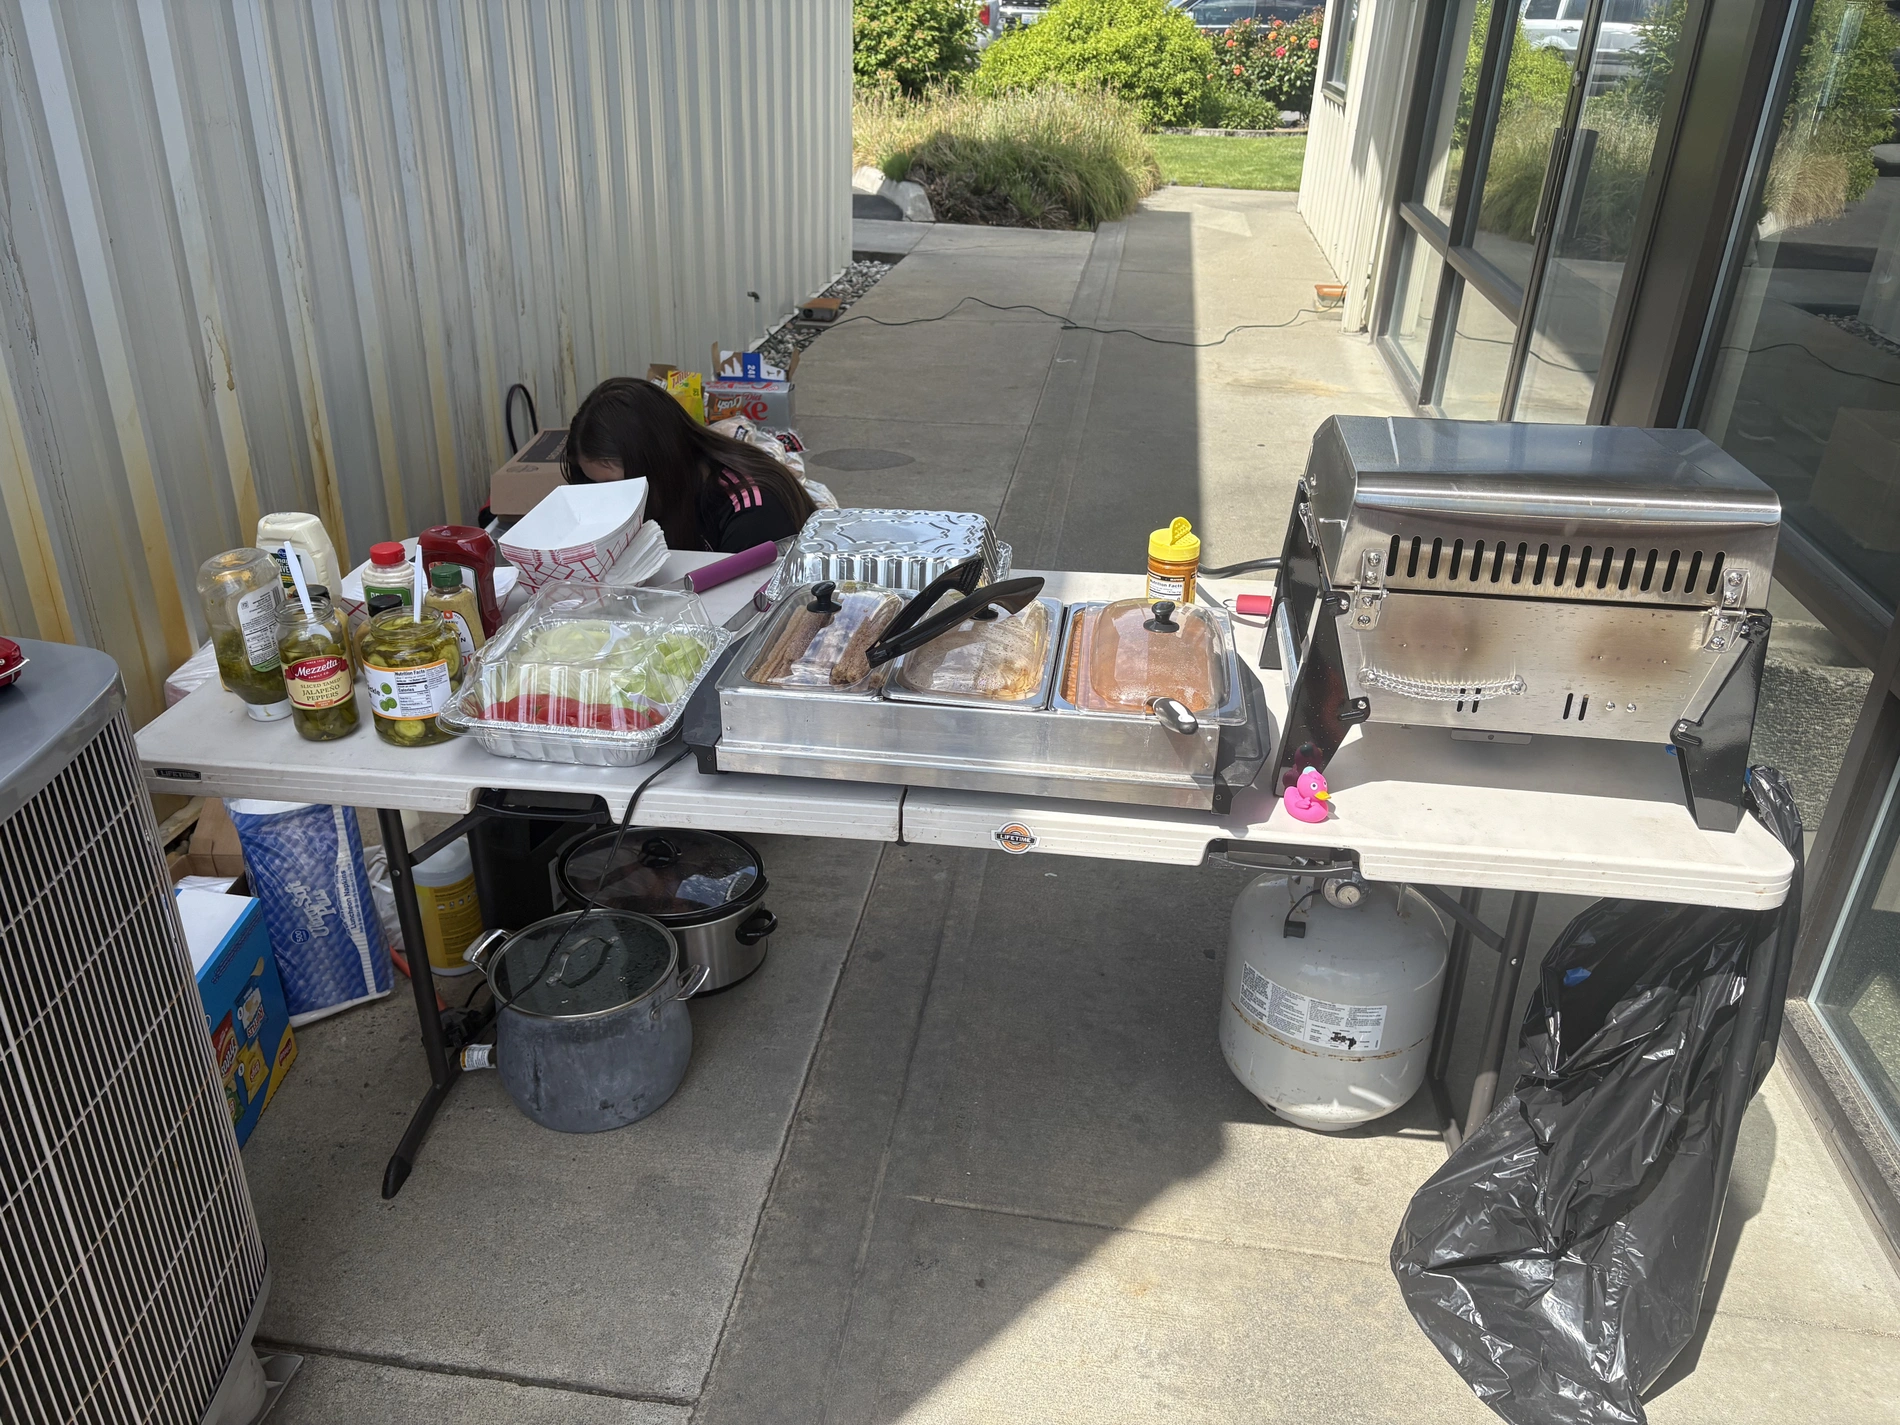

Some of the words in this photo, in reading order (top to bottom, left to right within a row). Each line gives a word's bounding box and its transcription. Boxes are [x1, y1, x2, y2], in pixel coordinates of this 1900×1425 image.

[717, 396, 742, 411] Crush
[295, 659, 338, 677] Mezzetta
[302, 684, 340, 696] JALAPEÑO
[306, 691, 339, 701] PEPPERS
[1000, 834, 1030, 842] LIFETIME
[341, 870, 350, 897] Napkins
[312, 889, 337, 917] Plus
[346, 898, 356, 929] Luncheon
